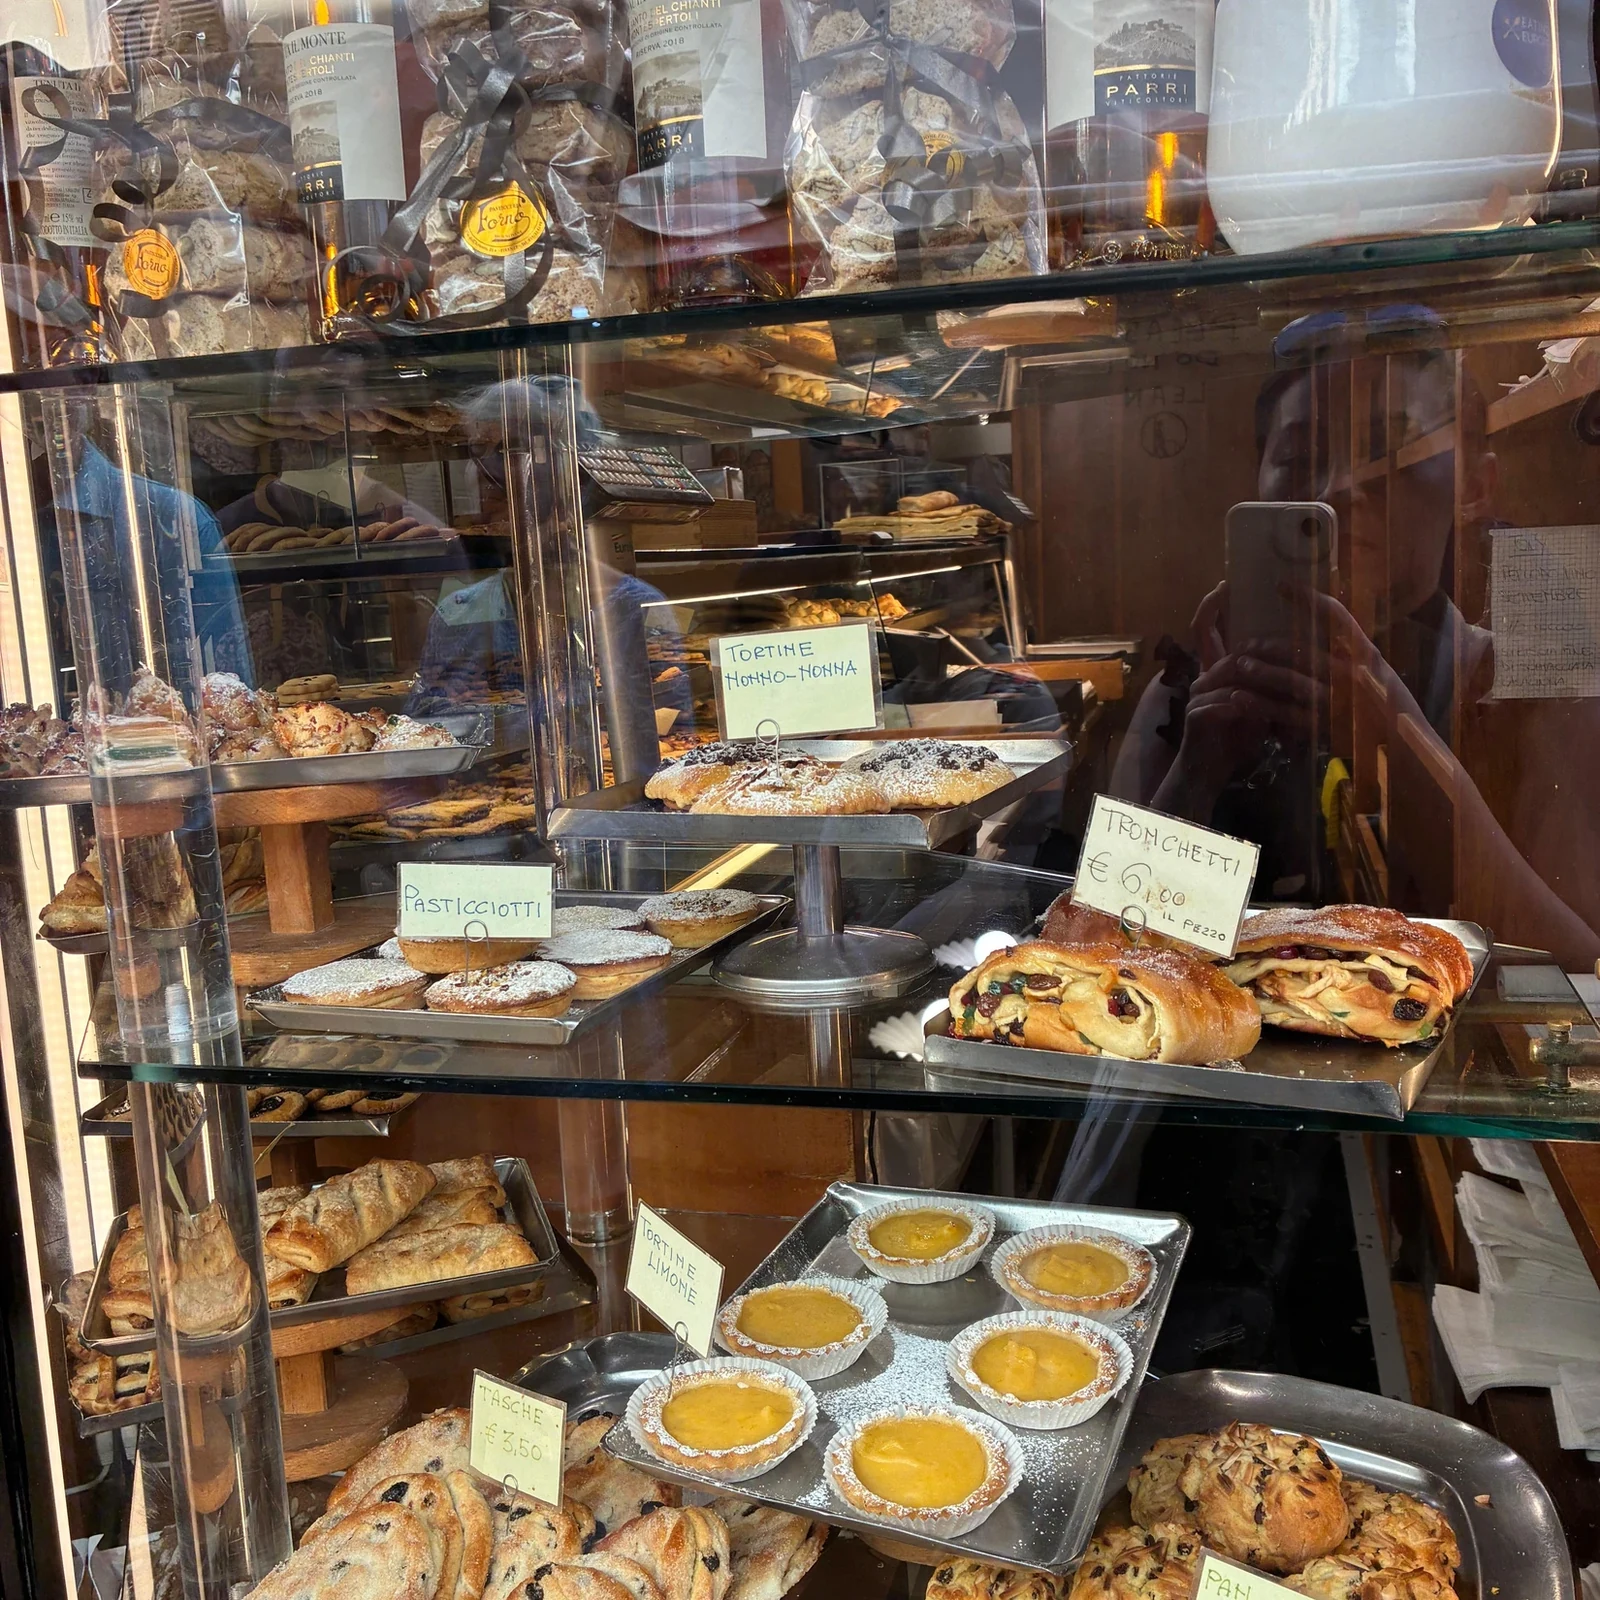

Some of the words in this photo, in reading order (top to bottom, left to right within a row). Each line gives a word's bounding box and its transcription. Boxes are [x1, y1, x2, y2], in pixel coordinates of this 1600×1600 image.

[671, 0, 721, 12] CHIANTI
[674, 23, 723, 32] CONTROLLATA
[301, 31, 347, 50] MONTE
[663, 37, 685, 48] 2018
[309, 52, 355, 65] CHIANTI
[1119, 73, 1177, 82] FATTORIE
[305, 88, 323, 98] 2018
[1106, 83, 1187, 99] PARRI
[1105, 97, 1188, 107] VITICOLTORI
[305, 177, 333, 192] RRI
[725, 641, 814, 663] TORTINE
[725, 660, 857, 690] NONNO-NONNA
[1101, 807, 1240, 876] TRONCHETTI
[404, 884, 541, 918] PASTICCIOTTI
[1162, 911, 1175, 922] IL
[1183, 918, 1227, 942] PEZZO
[640, 1215, 697, 1281] TORTINE
[647, 1250, 698, 1306] LIMONE
[479, 1384, 544, 1426] TASCHE
[503, 1429, 542, 1461] 3,50
[1205, 1568, 1252, 1600] PAN
